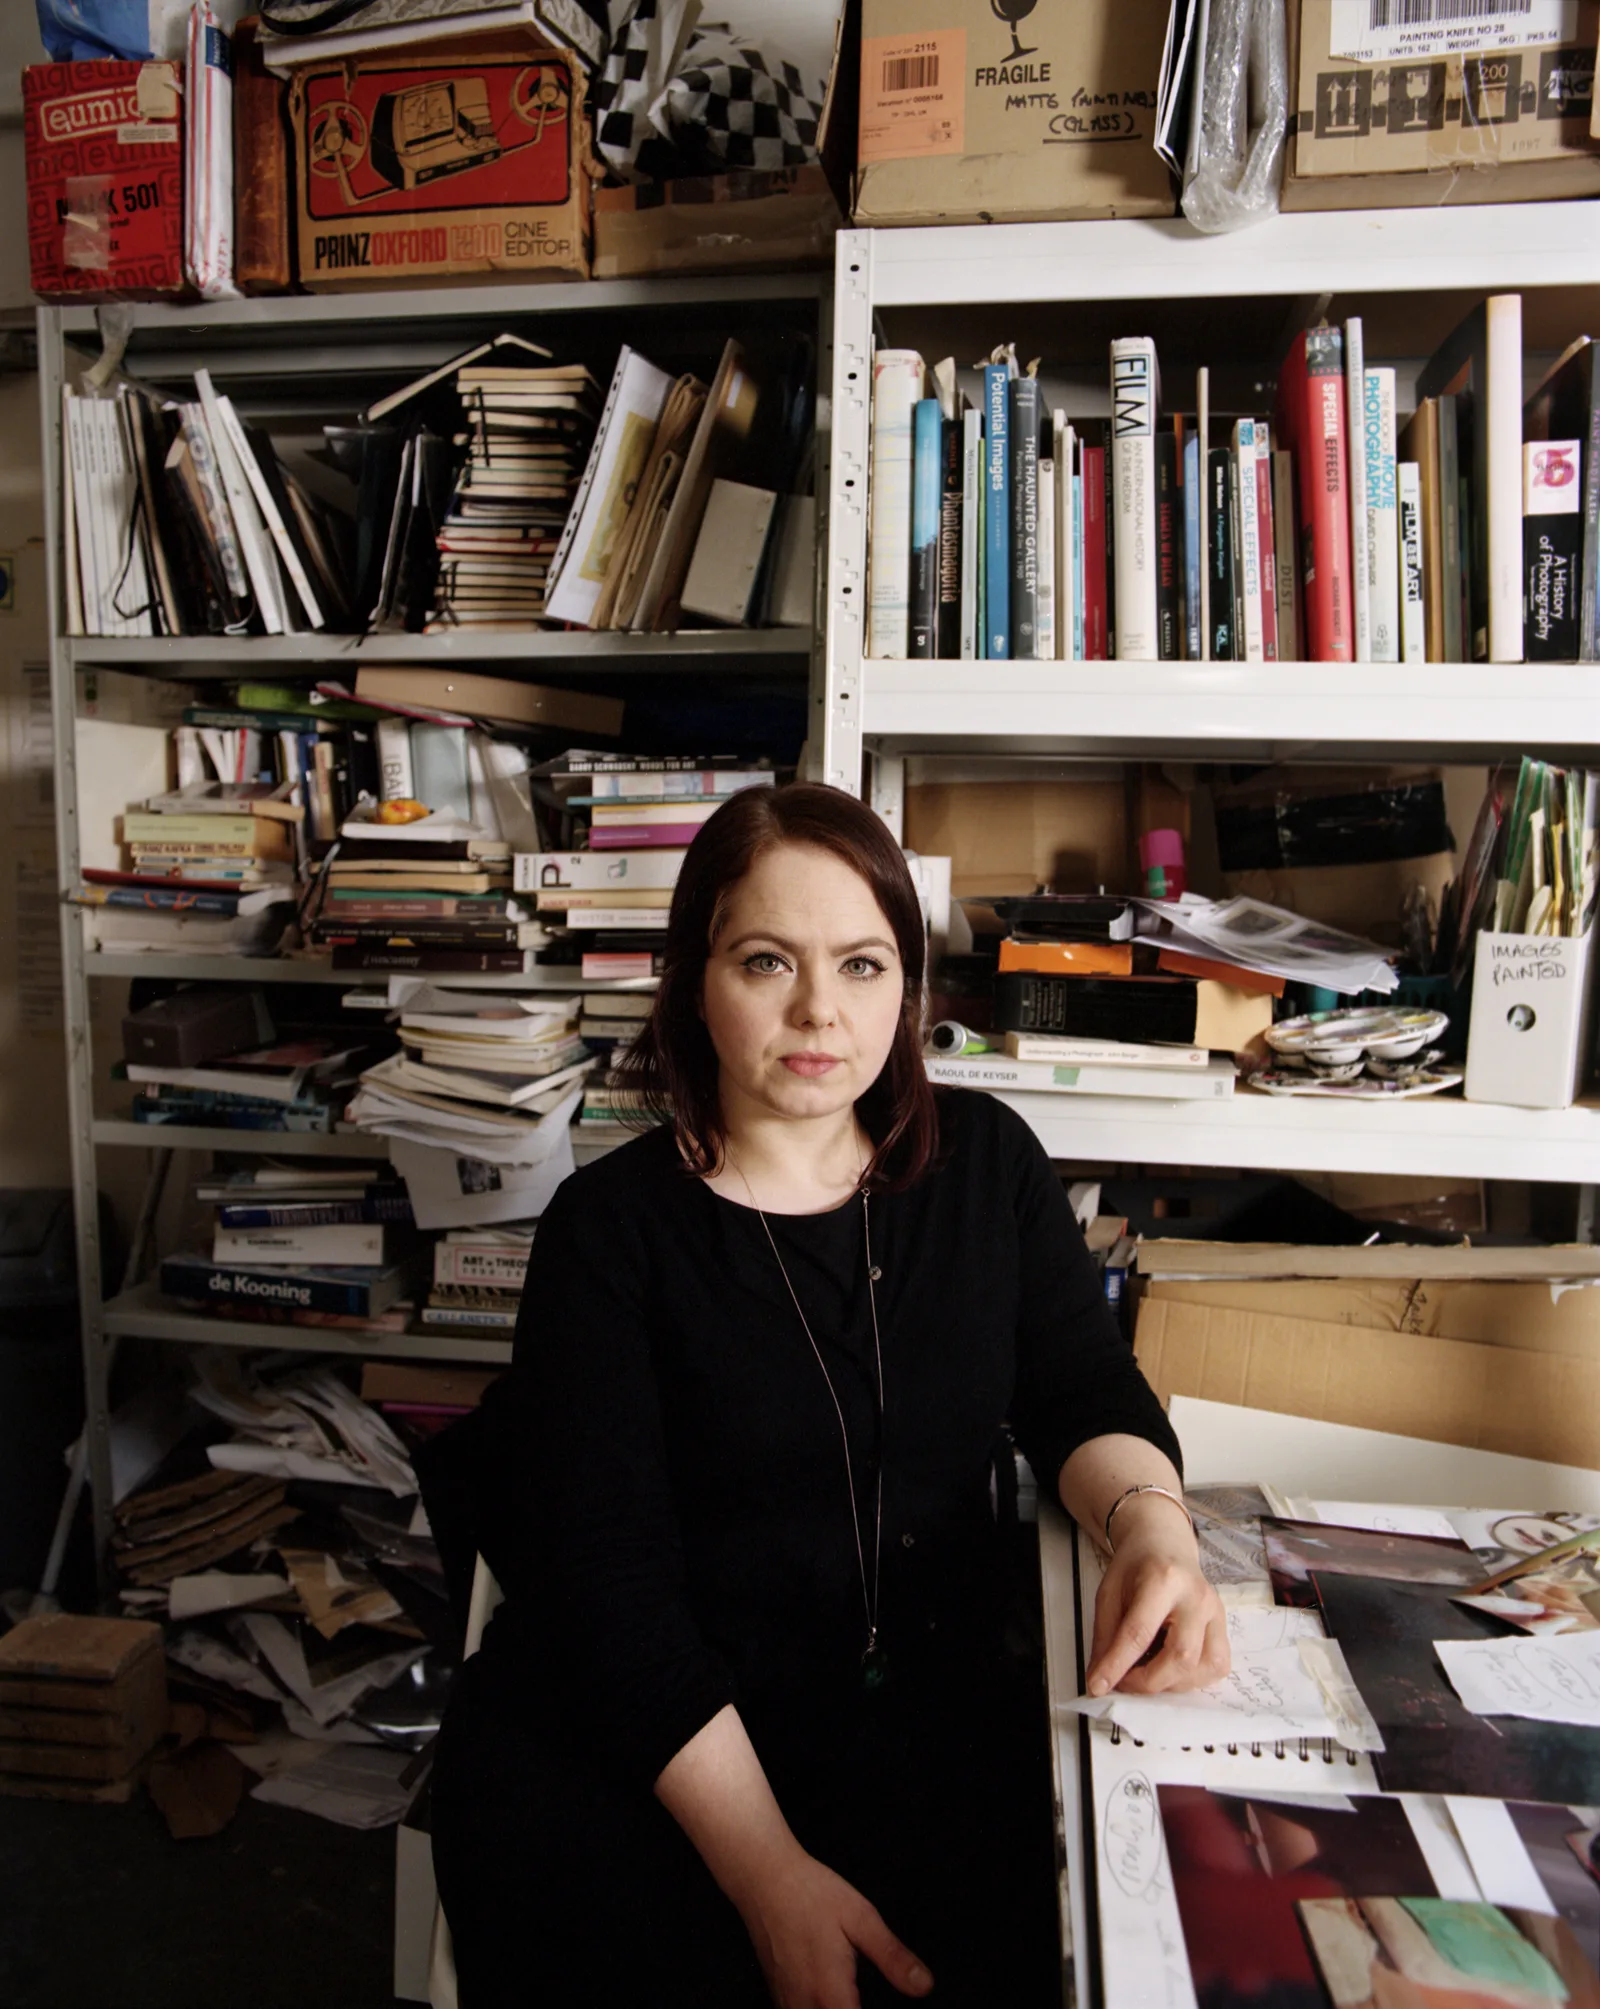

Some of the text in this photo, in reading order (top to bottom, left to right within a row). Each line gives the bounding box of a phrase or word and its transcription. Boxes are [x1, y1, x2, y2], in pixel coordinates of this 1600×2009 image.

[914, 41, 937, 53] 2115
[1400, 30, 1444, 43] PAINTING
[1446, 27, 1473, 39] KNIFE
[1477, 25, 1491, 36] NO
[1447, 38, 1480, 50] WEIGHT
[975, 63, 1050, 86] FRAGILE
[1481, 64, 1509, 80] 200
[123, 181, 159, 213] 501
[371, 226, 448, 267] OXFORD
[505, 220, 548, 239] CINE
[505, 239, 571, 258] EDITOR
[314, 231, 371, 270] PRINZ
[1115, 357, 1147, 436] FILM
[1322, 382, 1339, 439] SPECIAL
[988, 372, 1005, 491] Potential Images
[1365, 376, 1380, 509] PHOTOGRAPHY
[1122, 441, 1132, 513] OF THE MEDIUM
[1324, 439, 1341, 493] EFFECTS
[1382, 454, 1395, 510] MOVIE
[1025, 436, 1037, 595] THE HAUNTED GALLERY
[1133, 441, 1145, 571] AN INTERNATIONAL HISTORY
[1216, 485, 1224, 509] Nelson
[1588, 488, 1597, 524] FLESH
[1160, 502, 1172, 540] STAGES
[1242, 466, 1258, 596] SPECIAL EFFECTS
[1367, 509, 1376, 540] DAVID
[941, 492, 963, 603] Phantasmagoria
[1161, 556, 1173, 588] DECAY
[1280, 564, 1293, 609] DUST
[1535, 535, 1554, 641] of Photography
[1550, 555, 1568, 620] A History
[541, 863, 571, 888] P
[934, 1066, 1018, 1082] RAOUL DE KEYSER
[463, 1255, 484, 1267] ART
[496, 1257, 531, 1269] THEO
[208, 1272, 312, 1306] de Kooning
